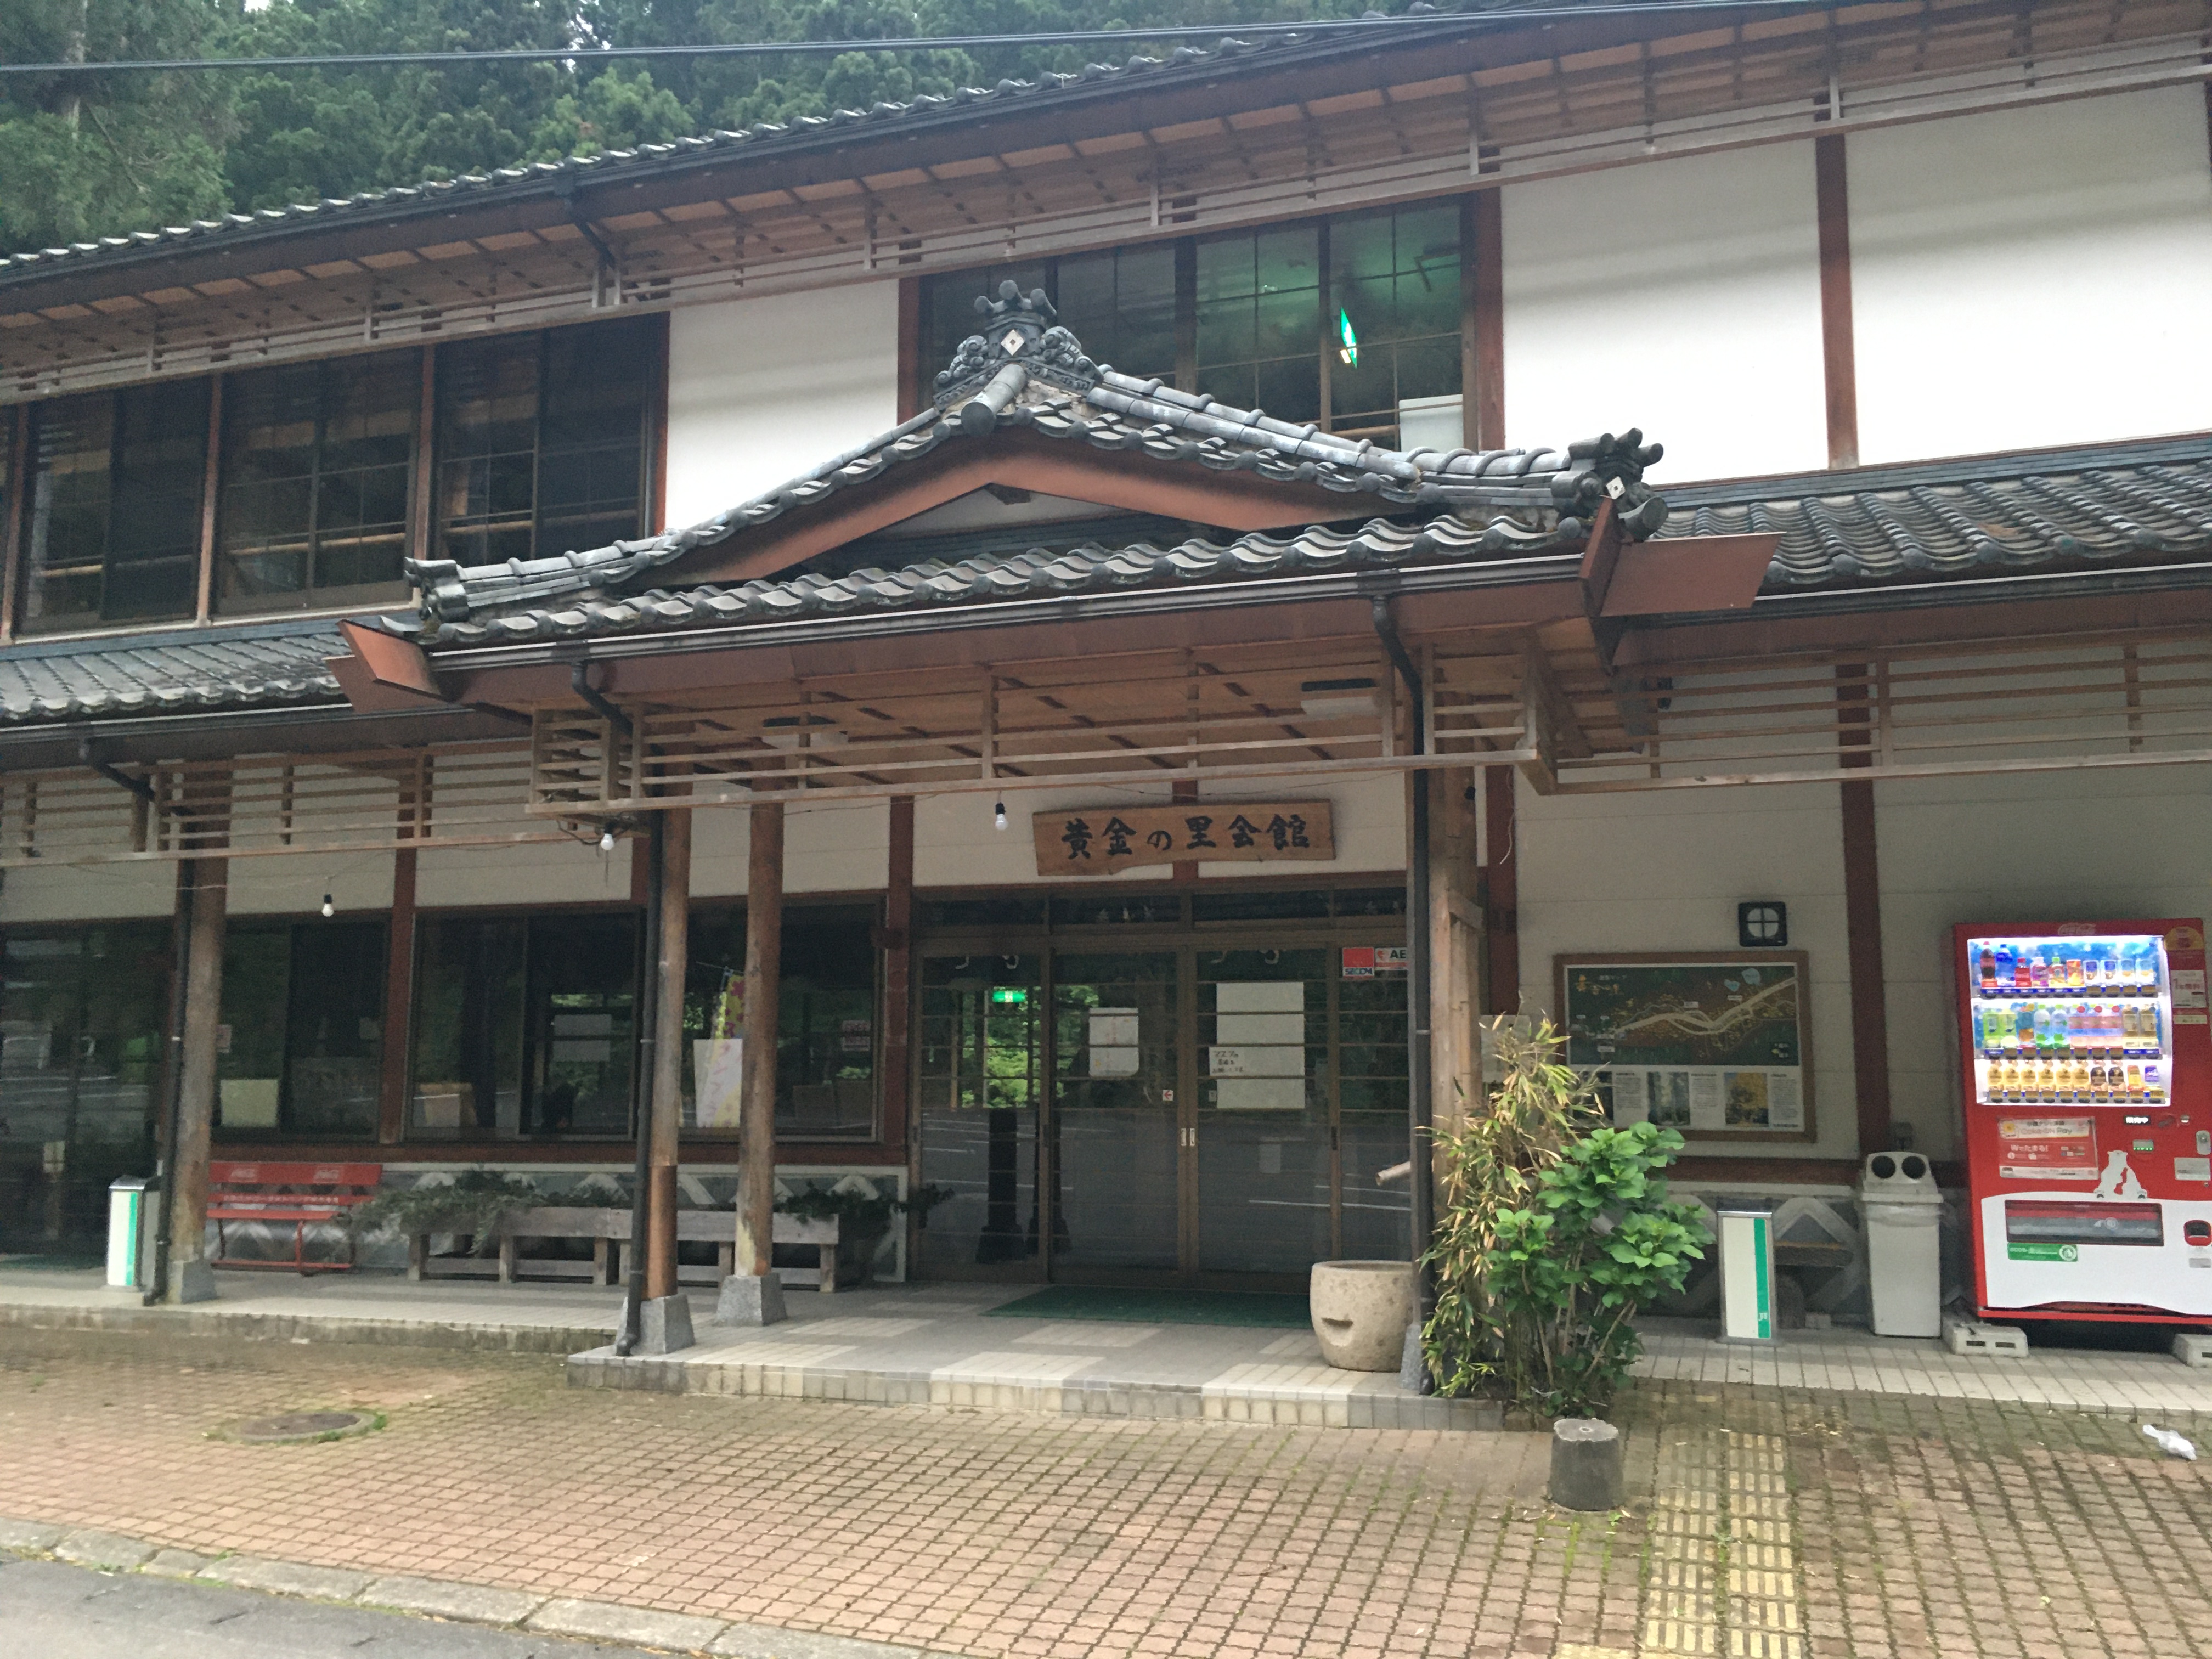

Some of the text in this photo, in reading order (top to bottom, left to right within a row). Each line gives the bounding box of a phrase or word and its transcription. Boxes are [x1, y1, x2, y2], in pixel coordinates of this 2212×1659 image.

[1061, 814, 1311, 860] 黄金の里会館
[1390, 949, 1407, 959] AE
[2056, 1127, 2072, 1135] Pay
